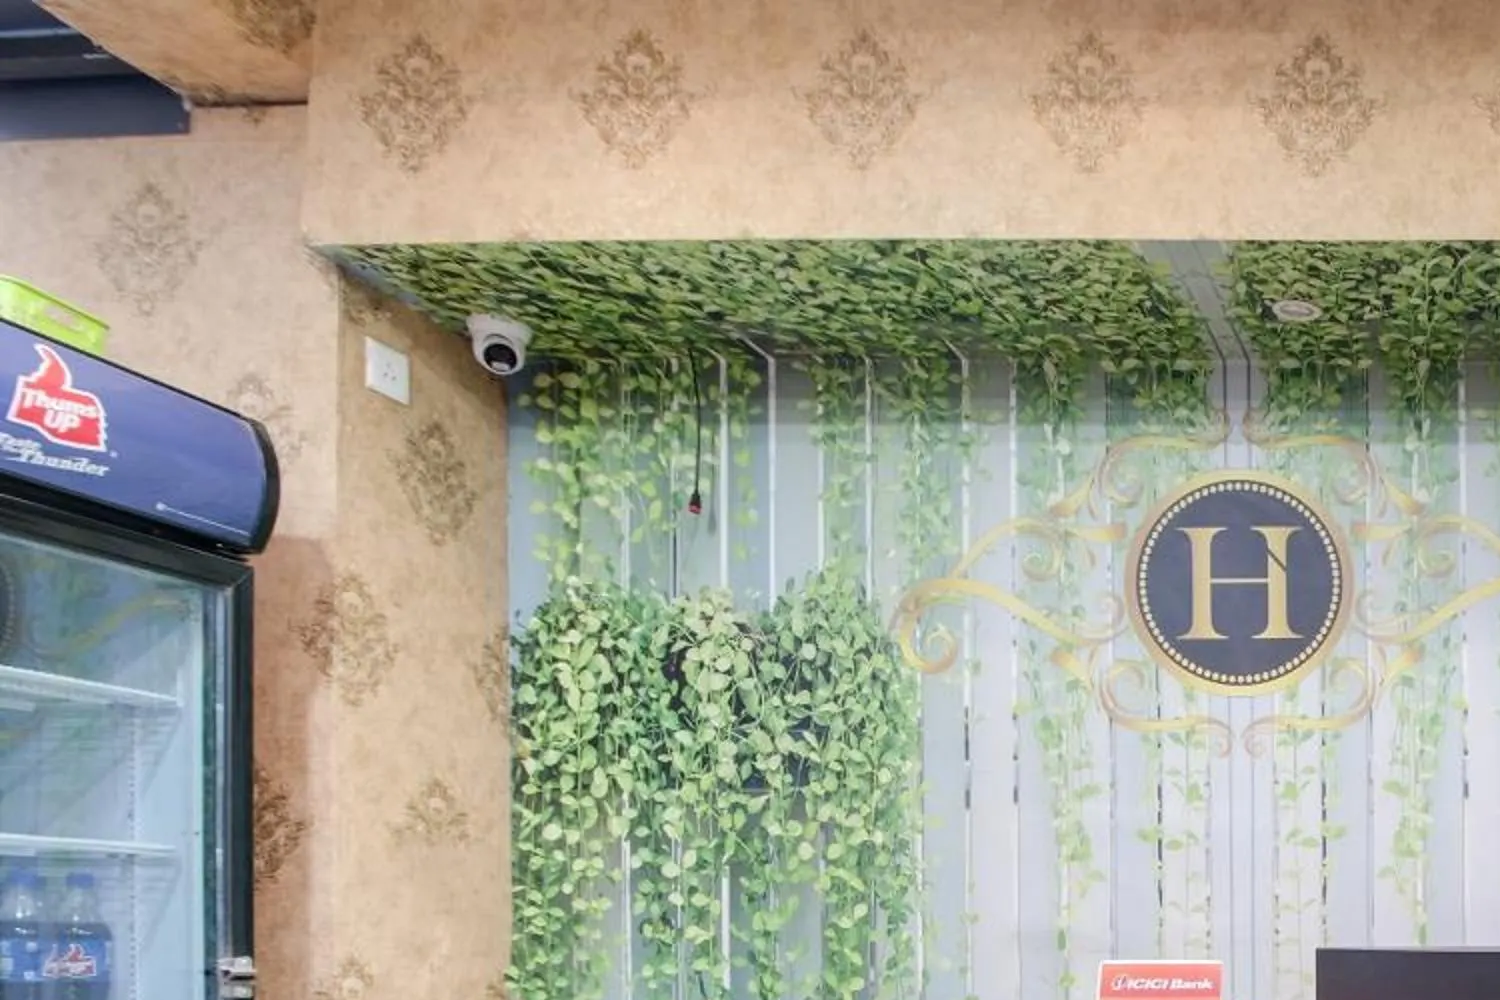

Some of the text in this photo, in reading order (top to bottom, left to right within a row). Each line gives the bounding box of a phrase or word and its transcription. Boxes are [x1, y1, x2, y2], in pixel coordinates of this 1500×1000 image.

[20, 387, 99, 419] Thums
[43, 409, 81, 433] UP
[1174, 525, 1305, 641] H
[1170, 978, 1214, 990] Bank
